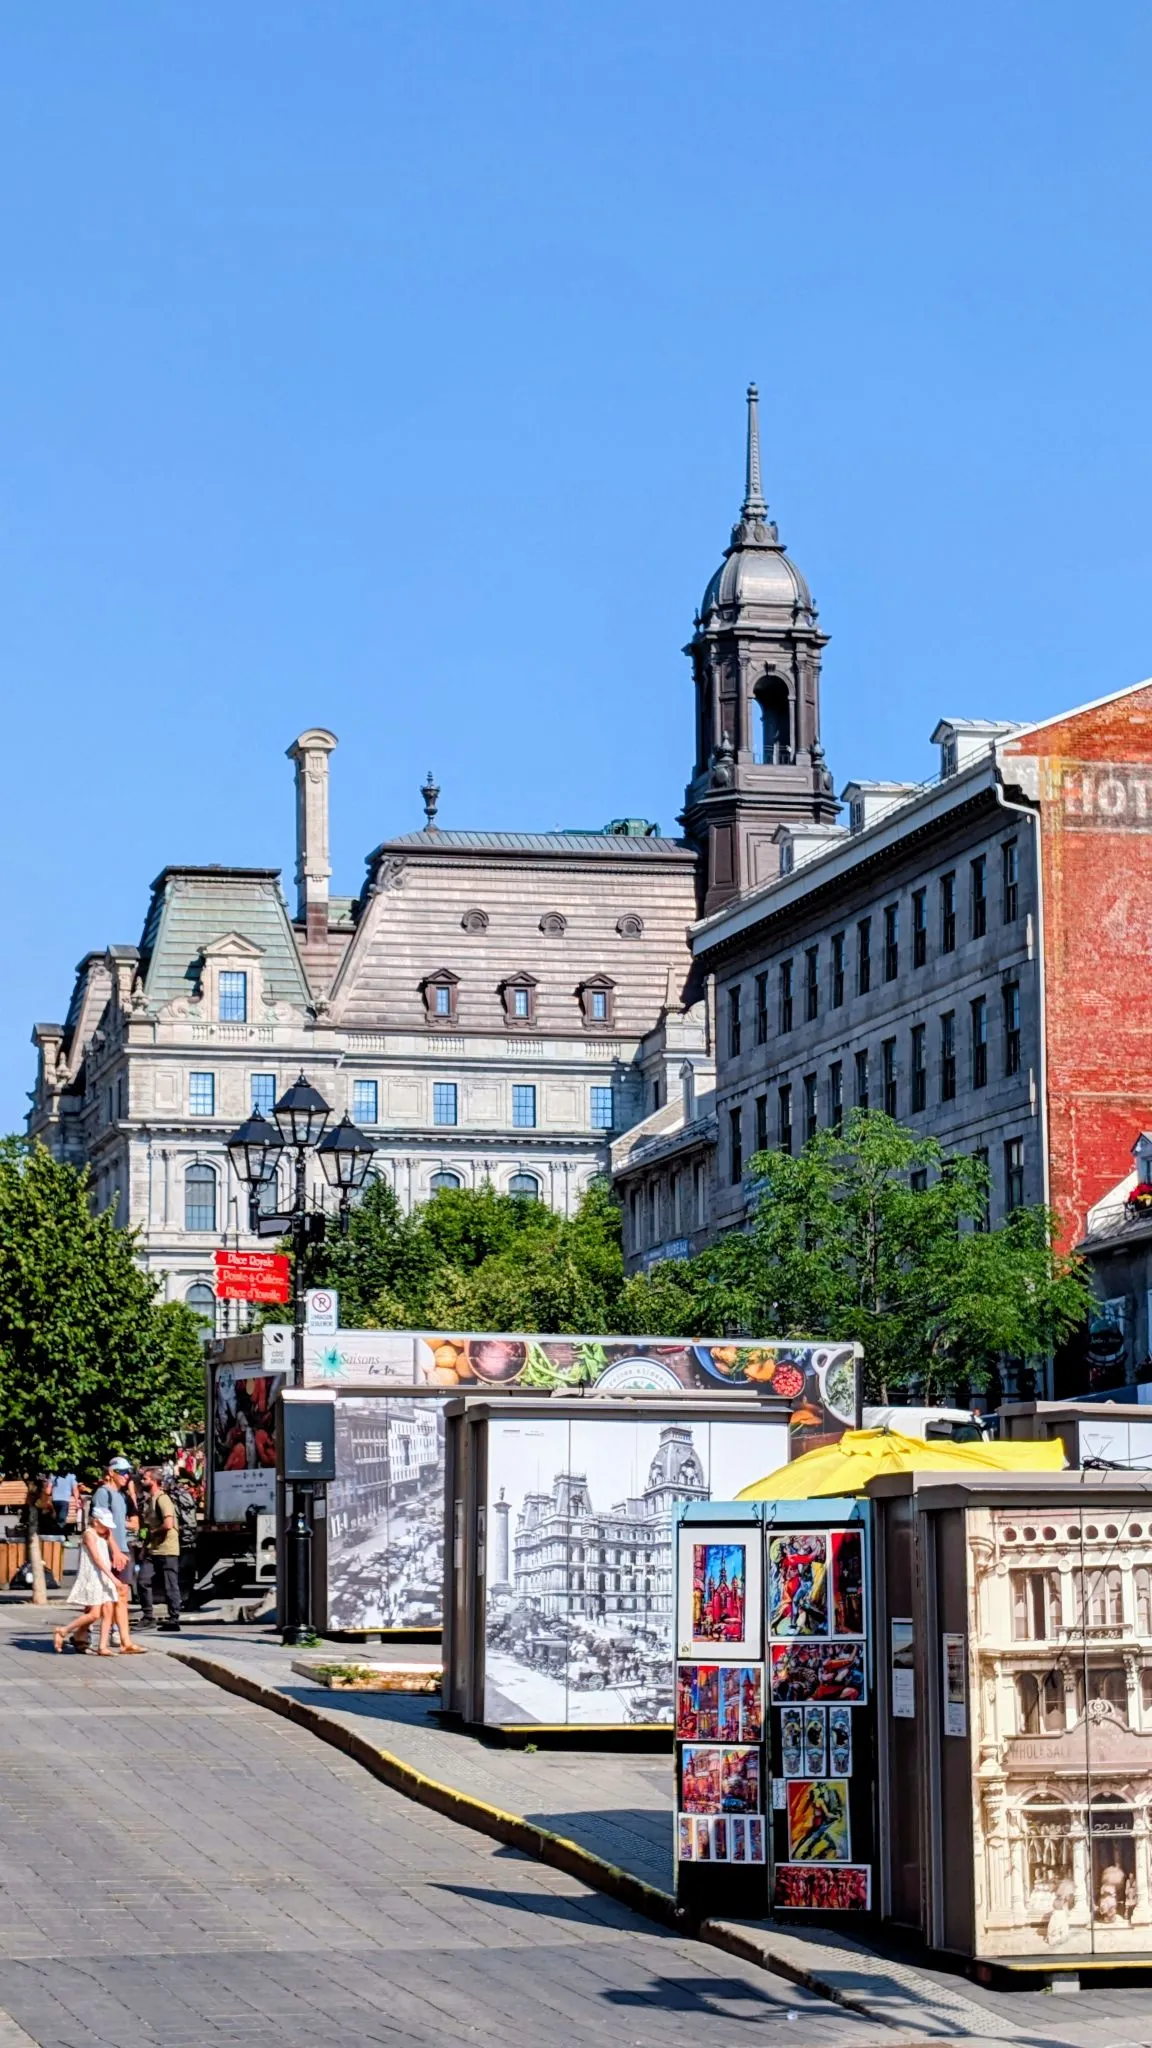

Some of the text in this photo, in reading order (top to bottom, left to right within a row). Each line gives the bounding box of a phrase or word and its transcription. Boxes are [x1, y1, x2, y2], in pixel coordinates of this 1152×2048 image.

[227, 1253, 275, 1268] Place Royale
[226, 1286, 246, 1298] Place
[339, 1351, 380, 1365] Saisons
